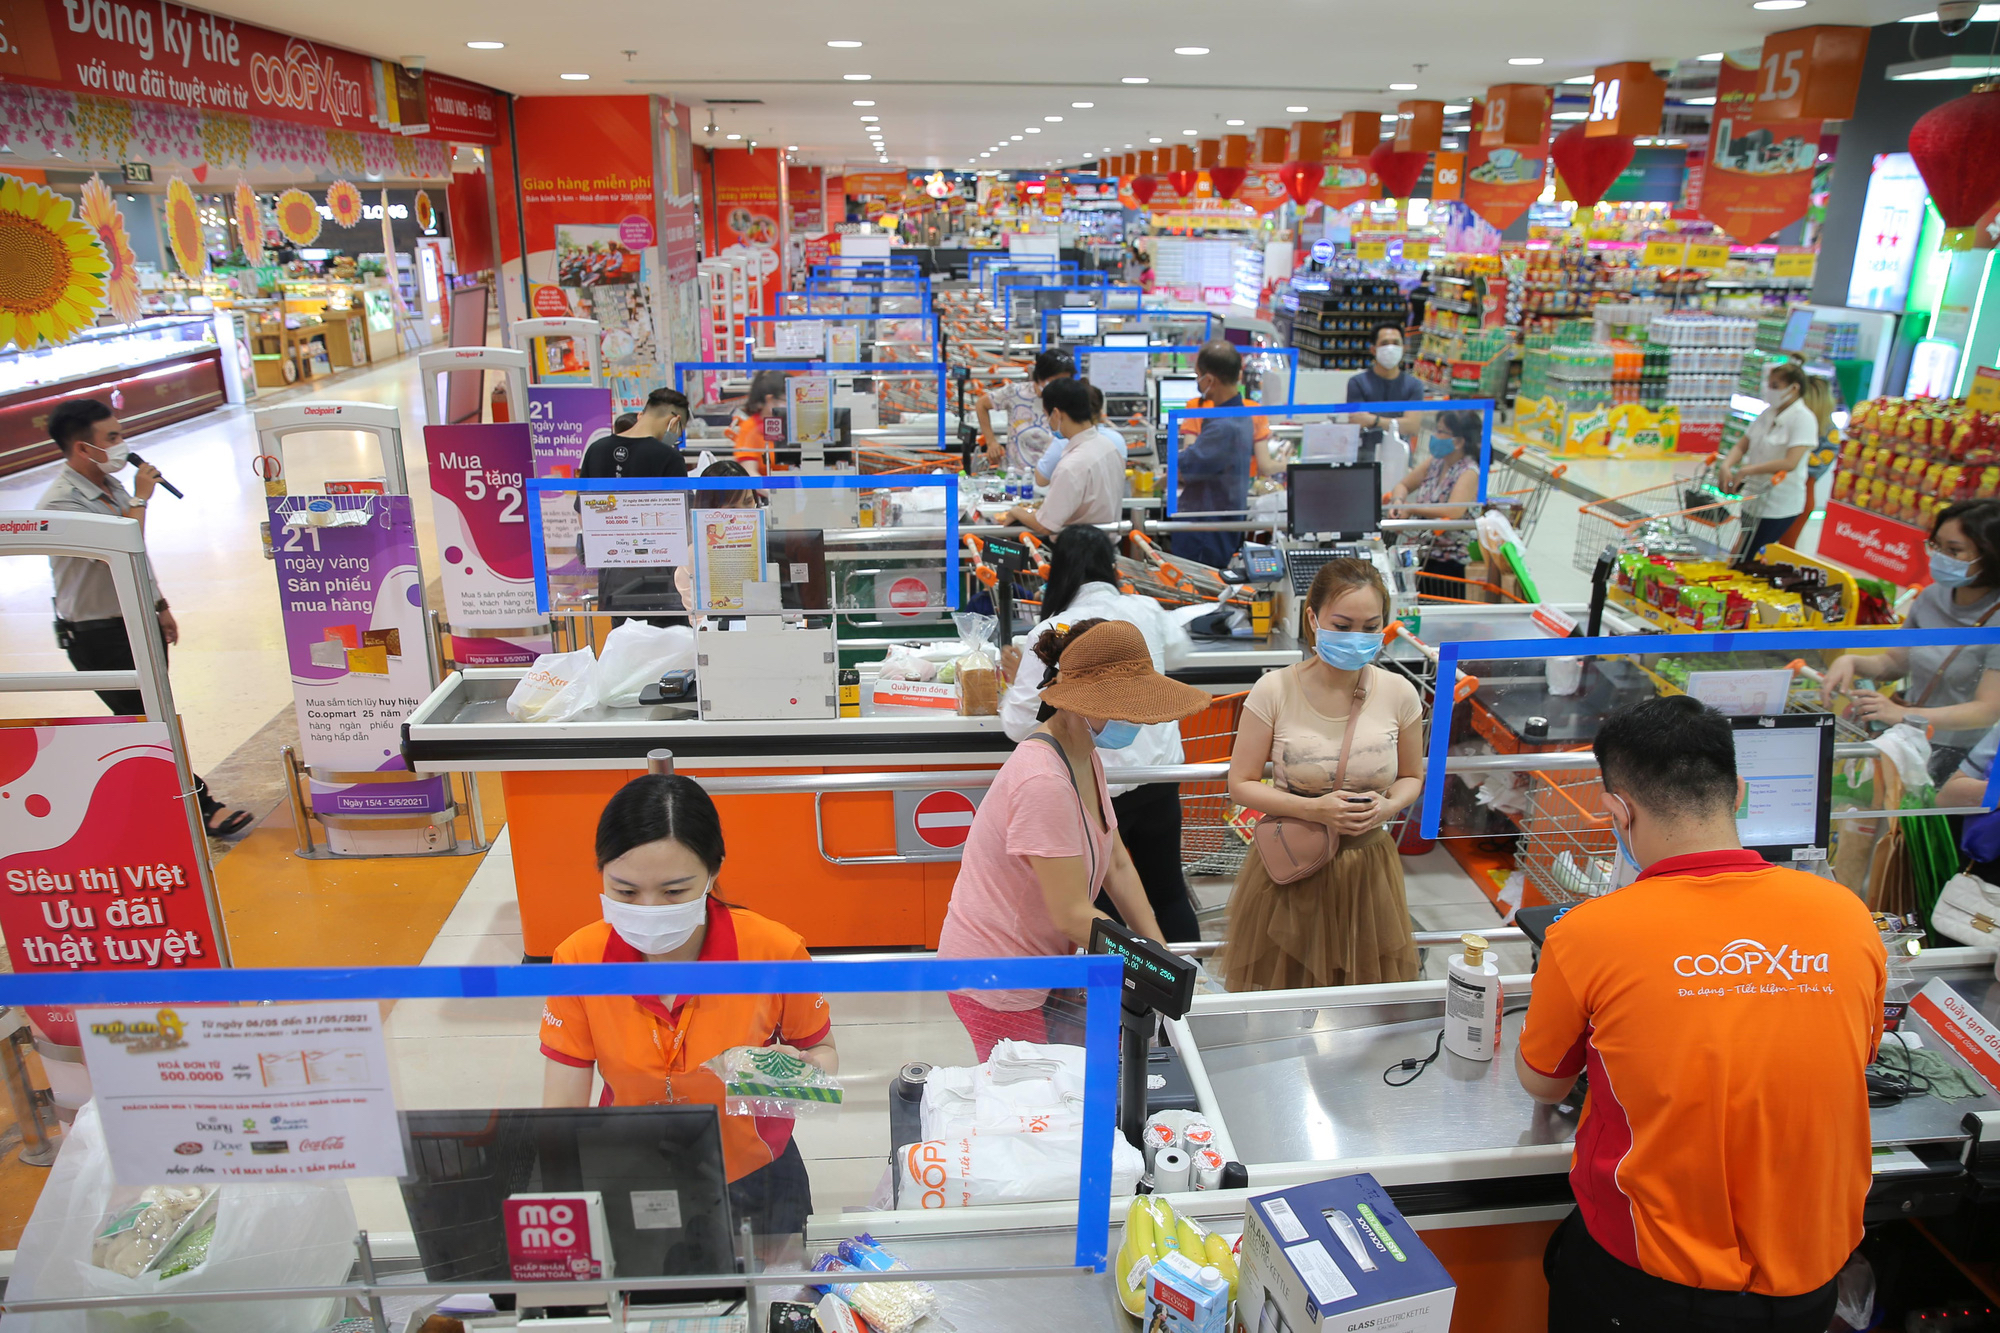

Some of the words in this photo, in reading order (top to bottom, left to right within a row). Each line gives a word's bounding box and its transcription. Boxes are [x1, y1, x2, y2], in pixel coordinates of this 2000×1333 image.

[161, 2, 192, 68] ký
[199, 15, 240, 66] thẻ
[77, 58, 108, 89] với
[112, 69, 136, 94] ưu
[141, 67, 166, 98] đãi
[169, 76, 207, 108] tuyệt
[209, 80, 232, 107] vời
[233, 84, 248, 109] từ
[1759, 50, 1803, 101] 15
[1589, 79, 1620, 121] 14
[1485, 98, 1506, 132] 13
[127, 164, 149, 180] EXIT
[1438, 169, 1458, 184] 06
[523, 178, 554, 190] Giao
[557, 177, 590, 192] hàng
[593, 174, 626, 189] miễn
[630, 176, 651, 190] phí
[304, 406, 335, 416] Checkpoint
[530, 401, 553, 419] 21
[557, 421, 582, 432] vàng
[553, 433, 582, 446] phiếu
[439, 452, 482, 469] Mua
[556, 448, 582, 458] hàng
[465, 470, 486, 500] 5
[485, 470, 522, 488] tặng
[497, 487, 524, 522] 2
[281, 525, 321, 552] 21
[1835, 521, 1882, 549] Khuyến
[1884, 542, 1910, 559] mãi
[284, 556, 324, 572] ngày
[328, 555, 370, 572] vàng
[1864, 549, 1907, 573] Promotion
[288, 578, 320, 592] Săn
[325, 575, 371, 594] phiếu
[497, 590, 516, 599] phẩm
[518, 590, 534, 598] cùng
[503, 599, 520, 607] hàng
[291, 601, 327, 612] mua
[331, 597, 373, 614] hàng
[517, 606, 536, 615] phẩm
[469, 656, 485, 664] Ngày
[891, 682, 911, 693] Quầy
[912, 684, 926, 693] tạm
[929, 685, 948, 695] đóng
[306, 699, 325, 707] Mua
[327, 698, 346, 706] sắm
[347, 698, 362, 706] tích
[364, 698, 377, 708] lũy
[378, 698, 396, 707] huy
[398, 697, 419, 706] hiệu
[308, 710, 356, 719] Co.opmart
[363, 710, 374, 718] 25
[380, 709, 401, 717] năm
[309, 722, 331, 731] hàng
[339, 722, 361, 731] ngàn
[370, 721, 394, 731] phiếu
[311, 733, 333, 742] hàng
[334, 732, 350, 741] hấp
[352, 732, 369, 741] dẫn
[343, 799, 363, 807] Ngày
[6, 868, 73, 893] Siêu
[79, 868, 119, 895] thị
[123, 863, 185, 892] Việt
[41, 899, 95, 929] Ưu
[106, 897, 165, 928] đãi
[23, 934, 96, 969] thật
[103, 929, 201, 966] tuyệt
[1678, 988, 1695, 996] Đa
[1698, 986, 1724, 996] dạng
[1734, 983, 1756, 993] Tiết
[1760, 984, 1788, 994] kiệm
[1797, 984, 1819, 993] Thú
[1823, 983, 1834, 994] vị
[202, 1020, 213, 1028] Từ
[216, 1020, 242, 1030] ngày
[246, 1018, 277, 1028] 06/05
[281, 1016, 302, 1026] đến
[305, 1014, 368, 1025] 31/05/2021
[1944, 997, 1967, 1020] Quầy
[1966, 1017, 1985, 1036] tạm
[1944, 1023, 1965, 1040] Counter
[1963, 1039, 1981, 1054] closed
[158, 1060, 180, 1069] HOÁ
[184, 1061, 205, 1069] ĐƠN
[209, 1060, 220, 1069] TỪ
[160, 1071, 223, 1081] 500.000Đ
[196, 1121, 232, 1133] Downy
[213, 1140, 243, 1150] Dove
[518, 1205, 573, 1225] mo
[521, 1227, 575, 1247] mo
[1249, 1215, 1270, 1254] GLASS
[1356, 1217, 1386, 1252] LOCK&LOCK
[1386, 1241, 1404, 1259] GLASS
[539, 1264, 565, 1272] NHẬN
[1247, 1225, 1270, 1268] ELECTRIC
[1269, 1262, 1290, 1301] KETTLE
[1347, 1320, 1375, 1332] GLASS
[1376, 1313, 1405, 1325] ELECTRIC
[1406, 1306, 1430, 1318] KETTLE
